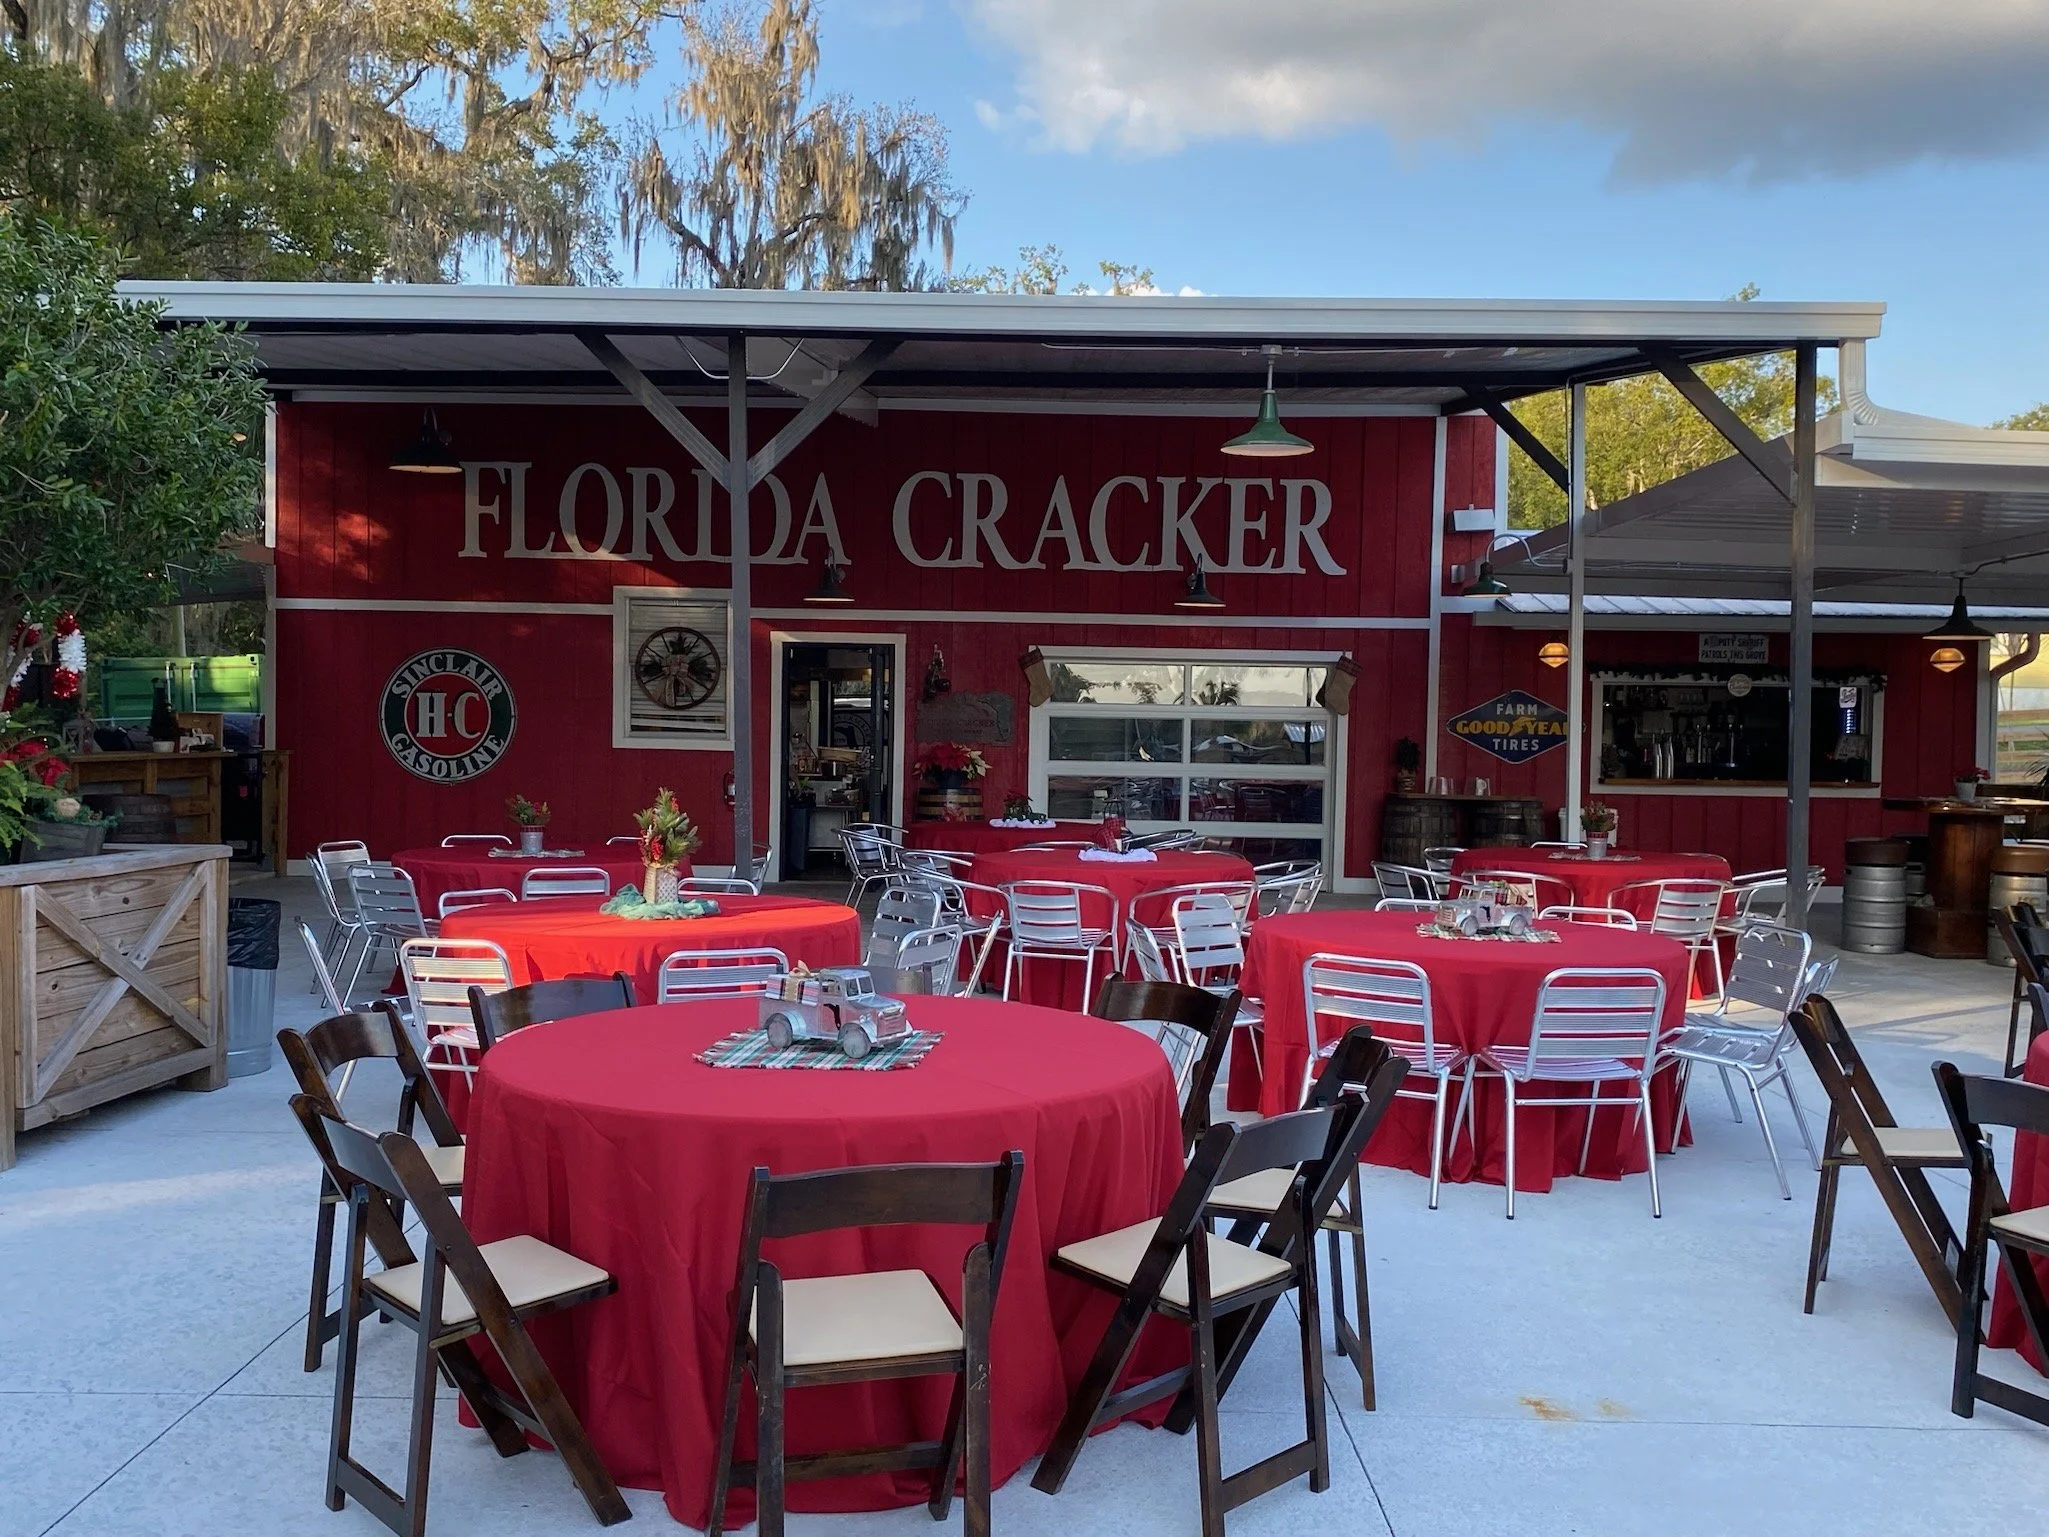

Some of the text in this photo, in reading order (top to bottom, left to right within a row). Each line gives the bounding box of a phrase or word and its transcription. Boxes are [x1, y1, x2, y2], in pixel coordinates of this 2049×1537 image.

[458, 461, 1348, 576] FLORIDA CRACKER
[391, 654, 503, 700] SINCLAIR
[1496, 703, 1538, 716] FARM
[391, 732, 505, 778] GASOLINE
[1493, 738, 1540, 751] TIRES
